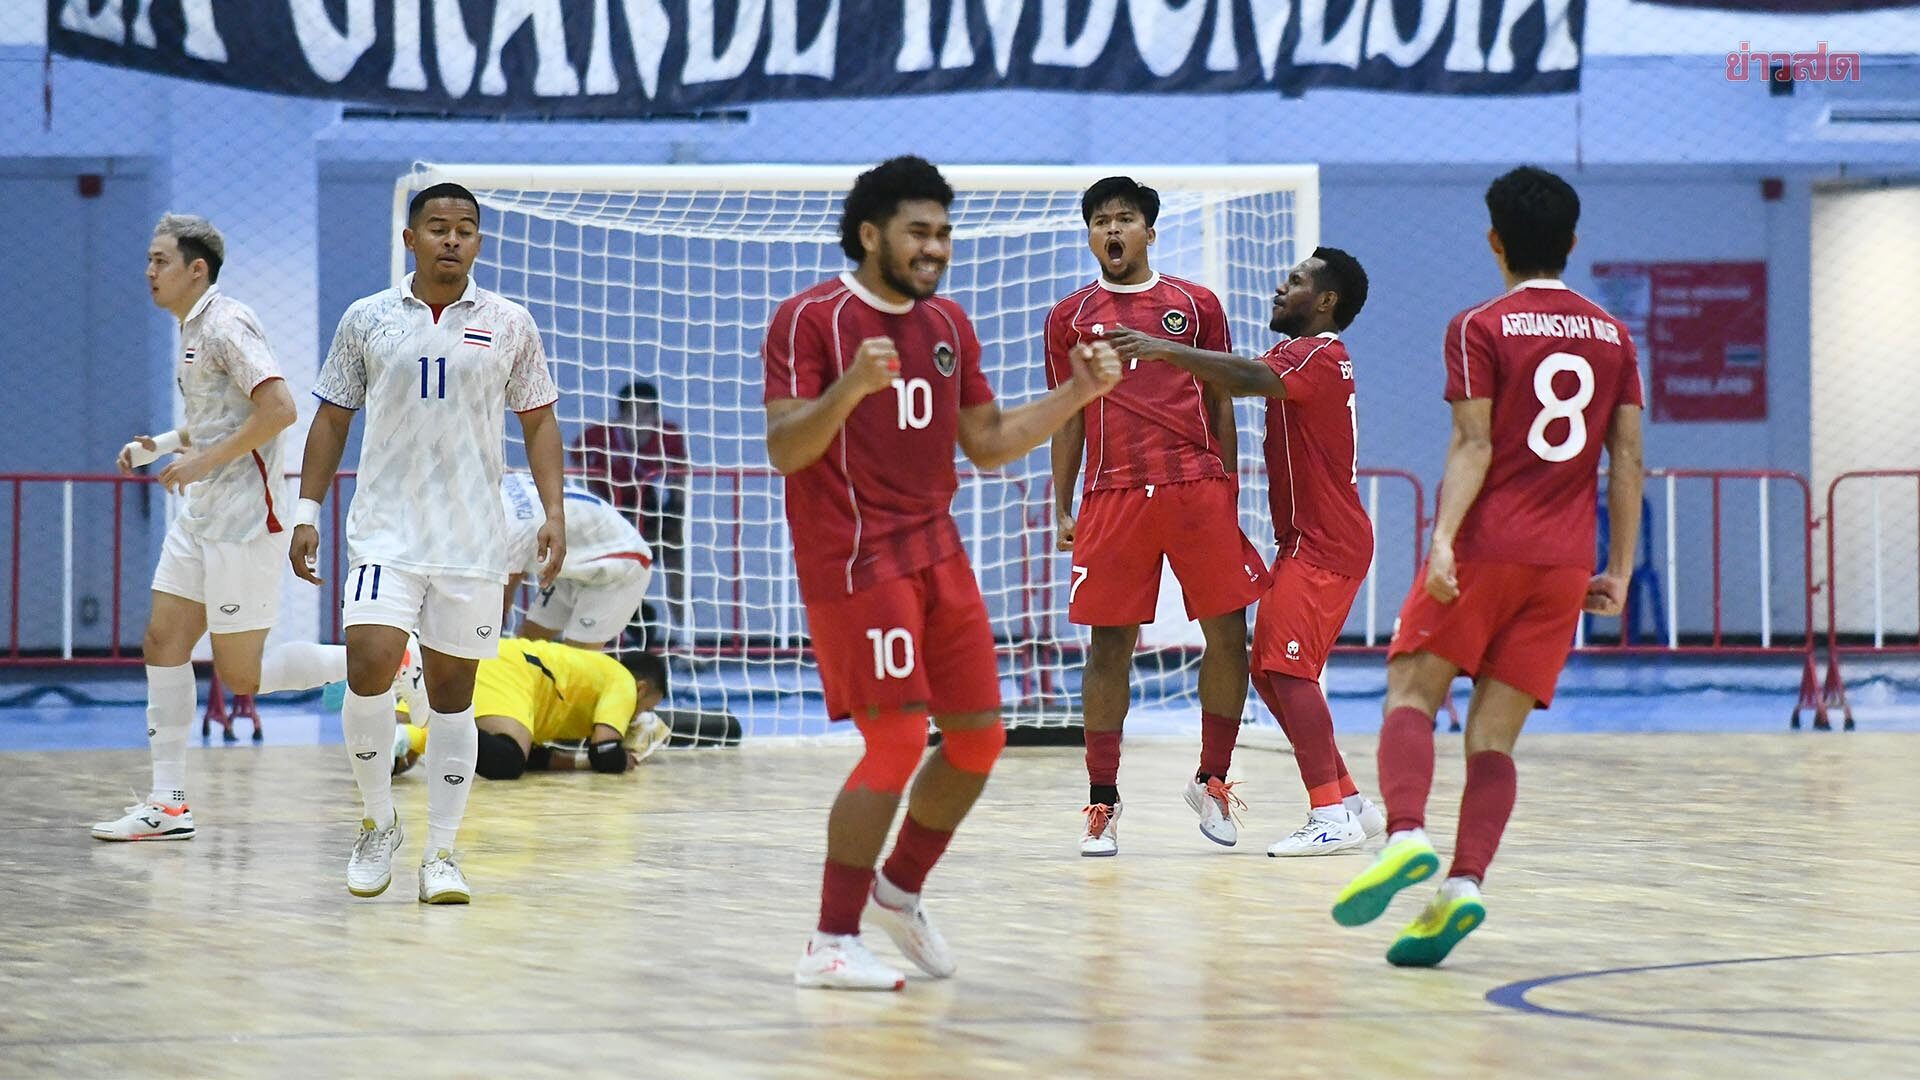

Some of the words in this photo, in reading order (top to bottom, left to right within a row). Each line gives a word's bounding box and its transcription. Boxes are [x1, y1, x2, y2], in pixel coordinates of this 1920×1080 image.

[1501, 312, 1592, 340] ARDIANSYAH
[417, 356, 447, 399] 11
[890, 377, 933, 430] 10
[1527, 352, 1595, 463] 8
[354, 564, 382, 601] 11
[1068, 565, 1088, 604] 7
[866, 627, 915, 680] 10
